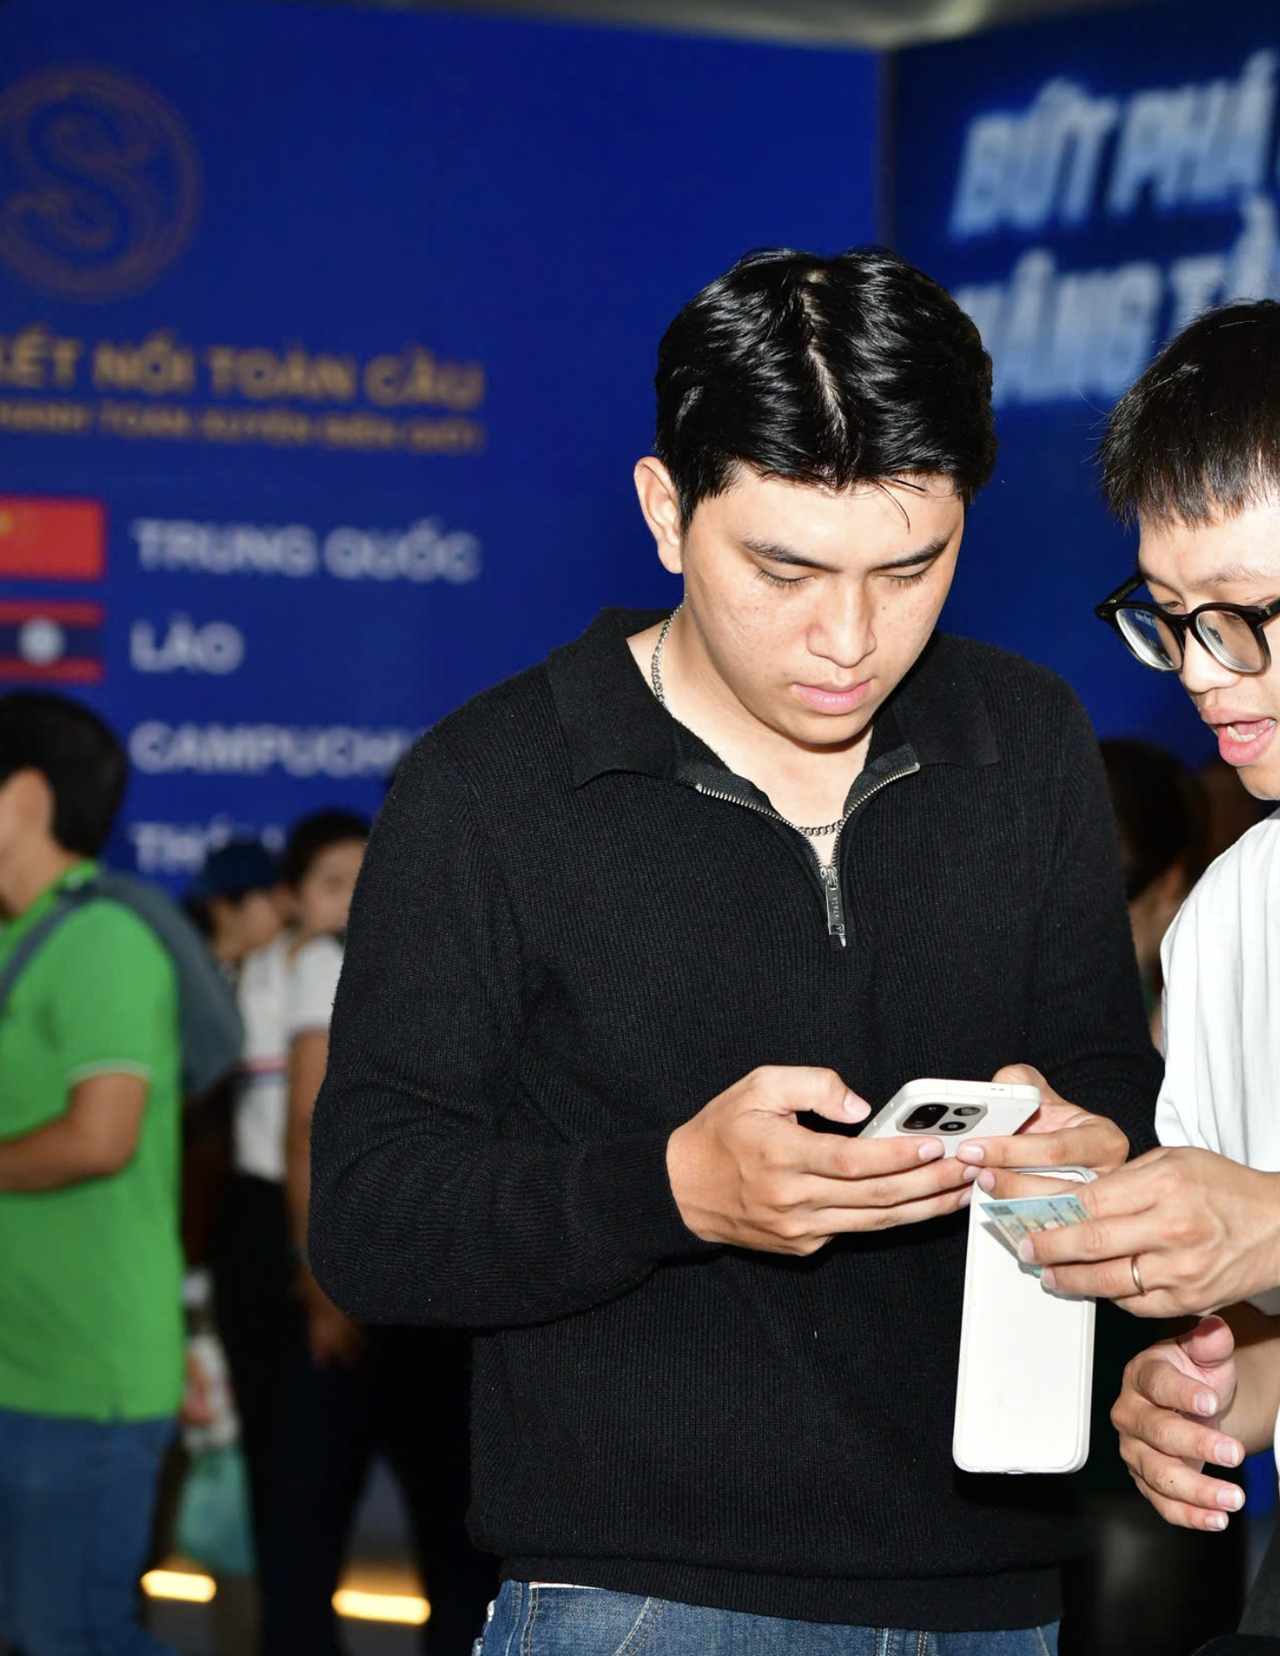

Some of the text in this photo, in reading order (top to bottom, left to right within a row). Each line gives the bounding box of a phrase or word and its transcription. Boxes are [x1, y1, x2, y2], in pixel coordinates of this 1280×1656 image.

[1106, 50, 1278, 213] PHÁ
[131, 514, 480, 584] TRUNG QUỐC
[130, 610, 244, 675] LÀO
